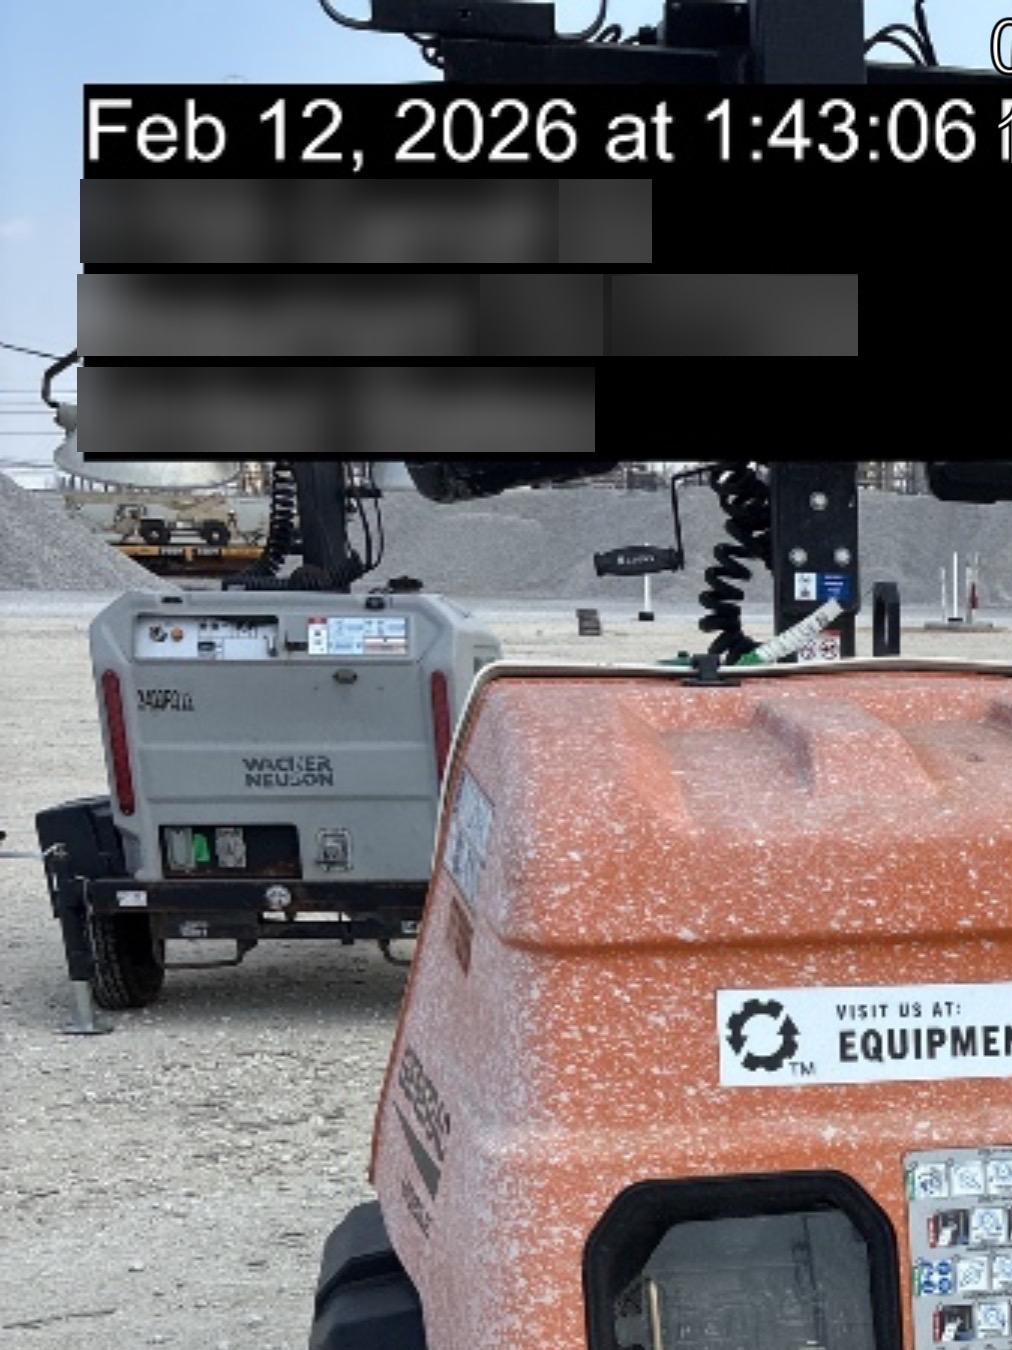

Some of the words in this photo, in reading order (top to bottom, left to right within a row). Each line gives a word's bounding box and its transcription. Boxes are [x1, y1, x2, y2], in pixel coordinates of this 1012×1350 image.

[836, 1004, 889, 1020] VISIT
[899, 1003, 922, 1018] US
[932, 1001, 962, 1018] AT:
[789, 1062, 816, 1075] TM
